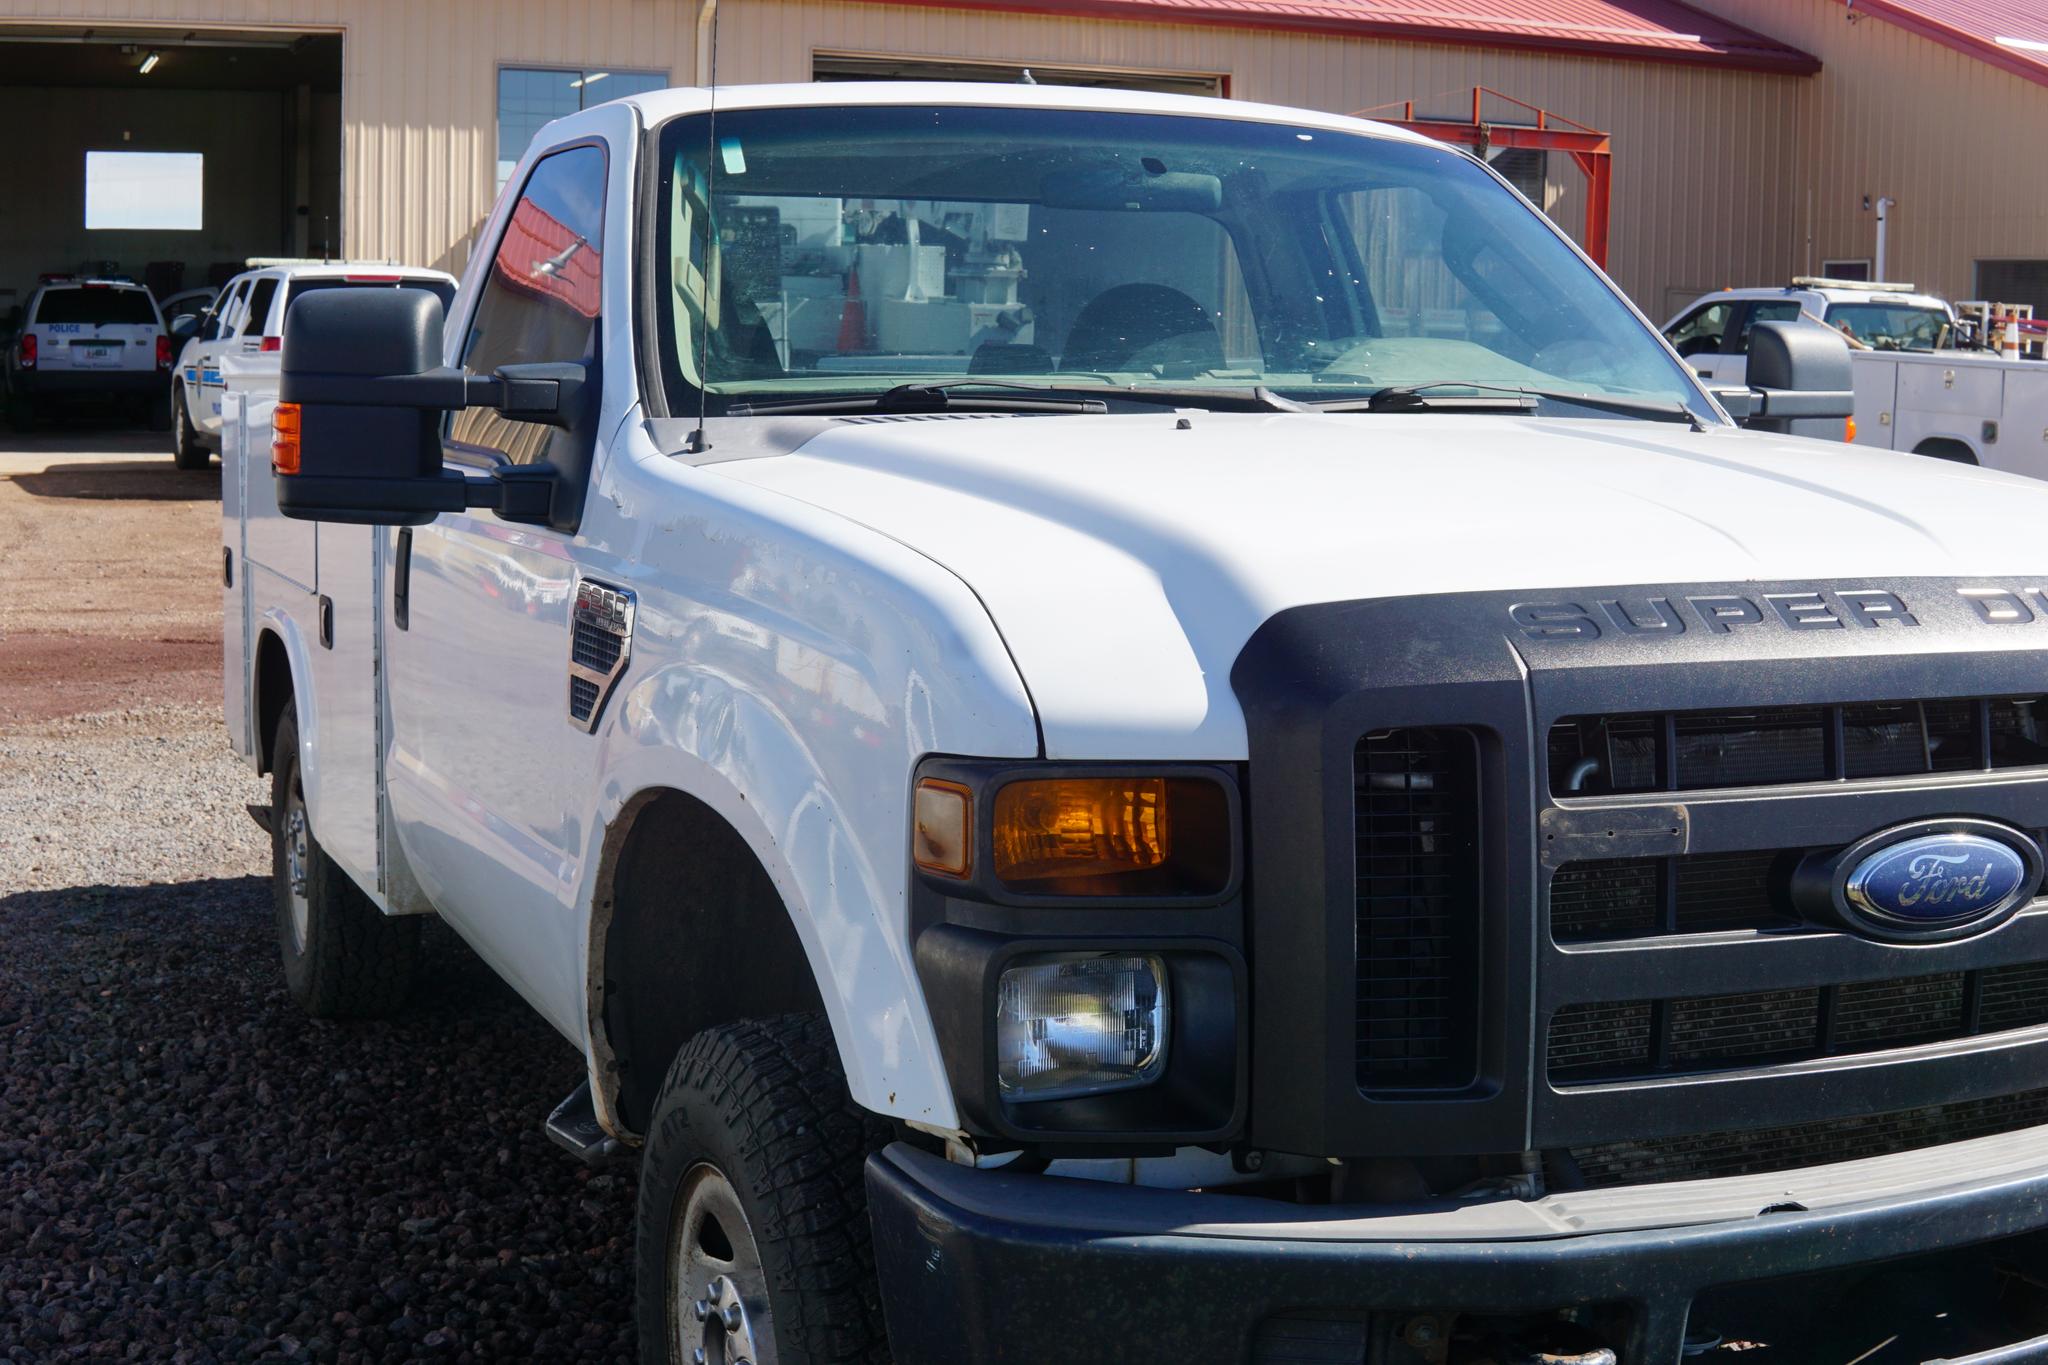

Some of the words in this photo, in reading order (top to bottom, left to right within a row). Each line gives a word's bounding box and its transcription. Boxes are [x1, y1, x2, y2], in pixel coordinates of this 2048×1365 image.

[48, 324, 81, 334] POLICE
[1508, 590, 1921, 640] SUPER
[1955, 588, 2048, 625] D
[1898, 853, 1993, 907] Ford
